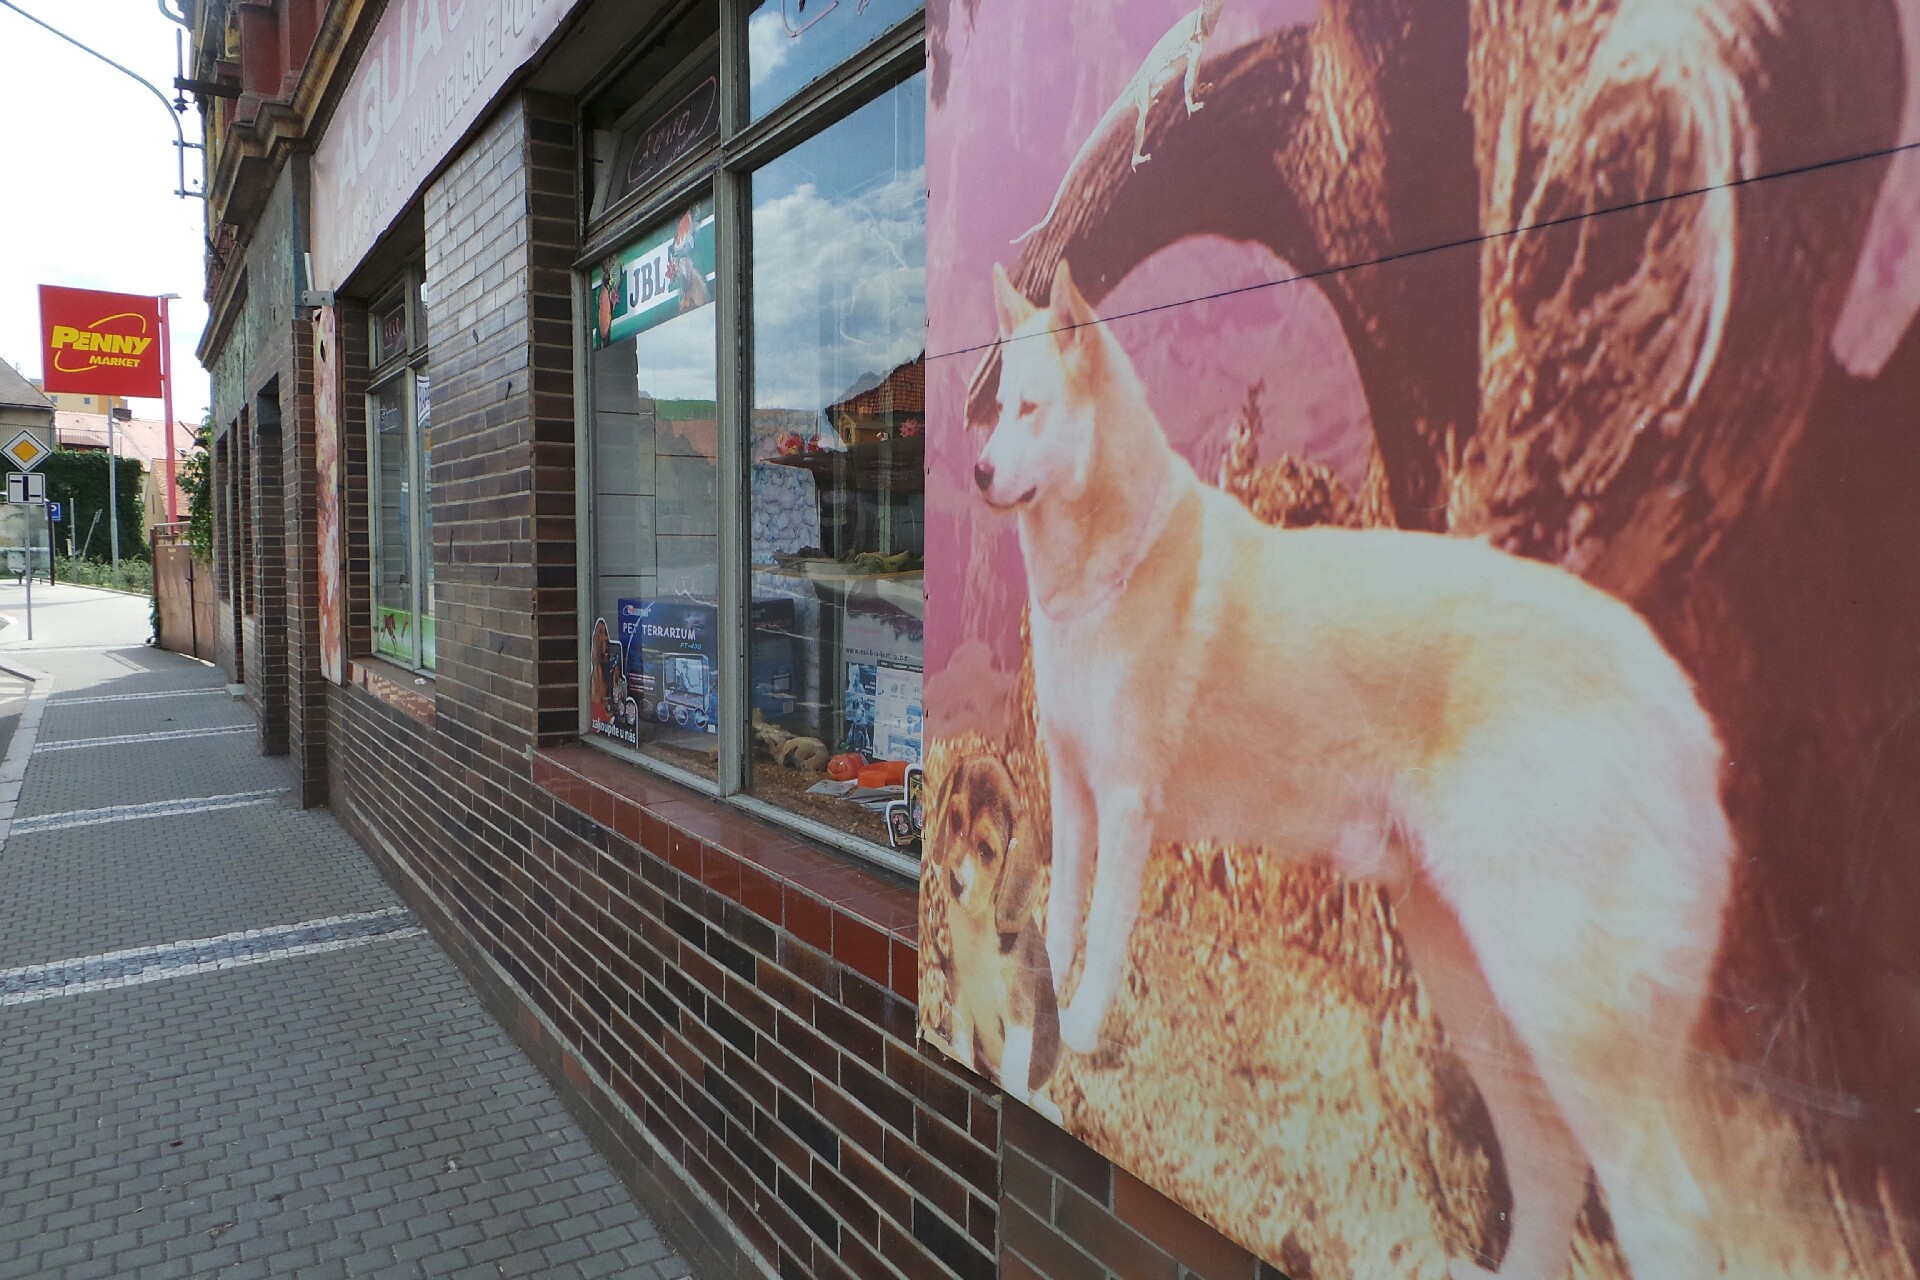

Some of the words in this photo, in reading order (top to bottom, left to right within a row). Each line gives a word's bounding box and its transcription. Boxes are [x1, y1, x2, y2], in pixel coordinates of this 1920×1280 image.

[336, 0, 467, 209] AQUA
[629, 256, 666, 308] JBL
[51, 325, 152, 355] PENNY
[89, 355, 140, 368] MARKET
[623, 622, 638, 634] PET
[641, 624, 696, 641] TERRARIUM
[624, 728, 636, 743] nás
